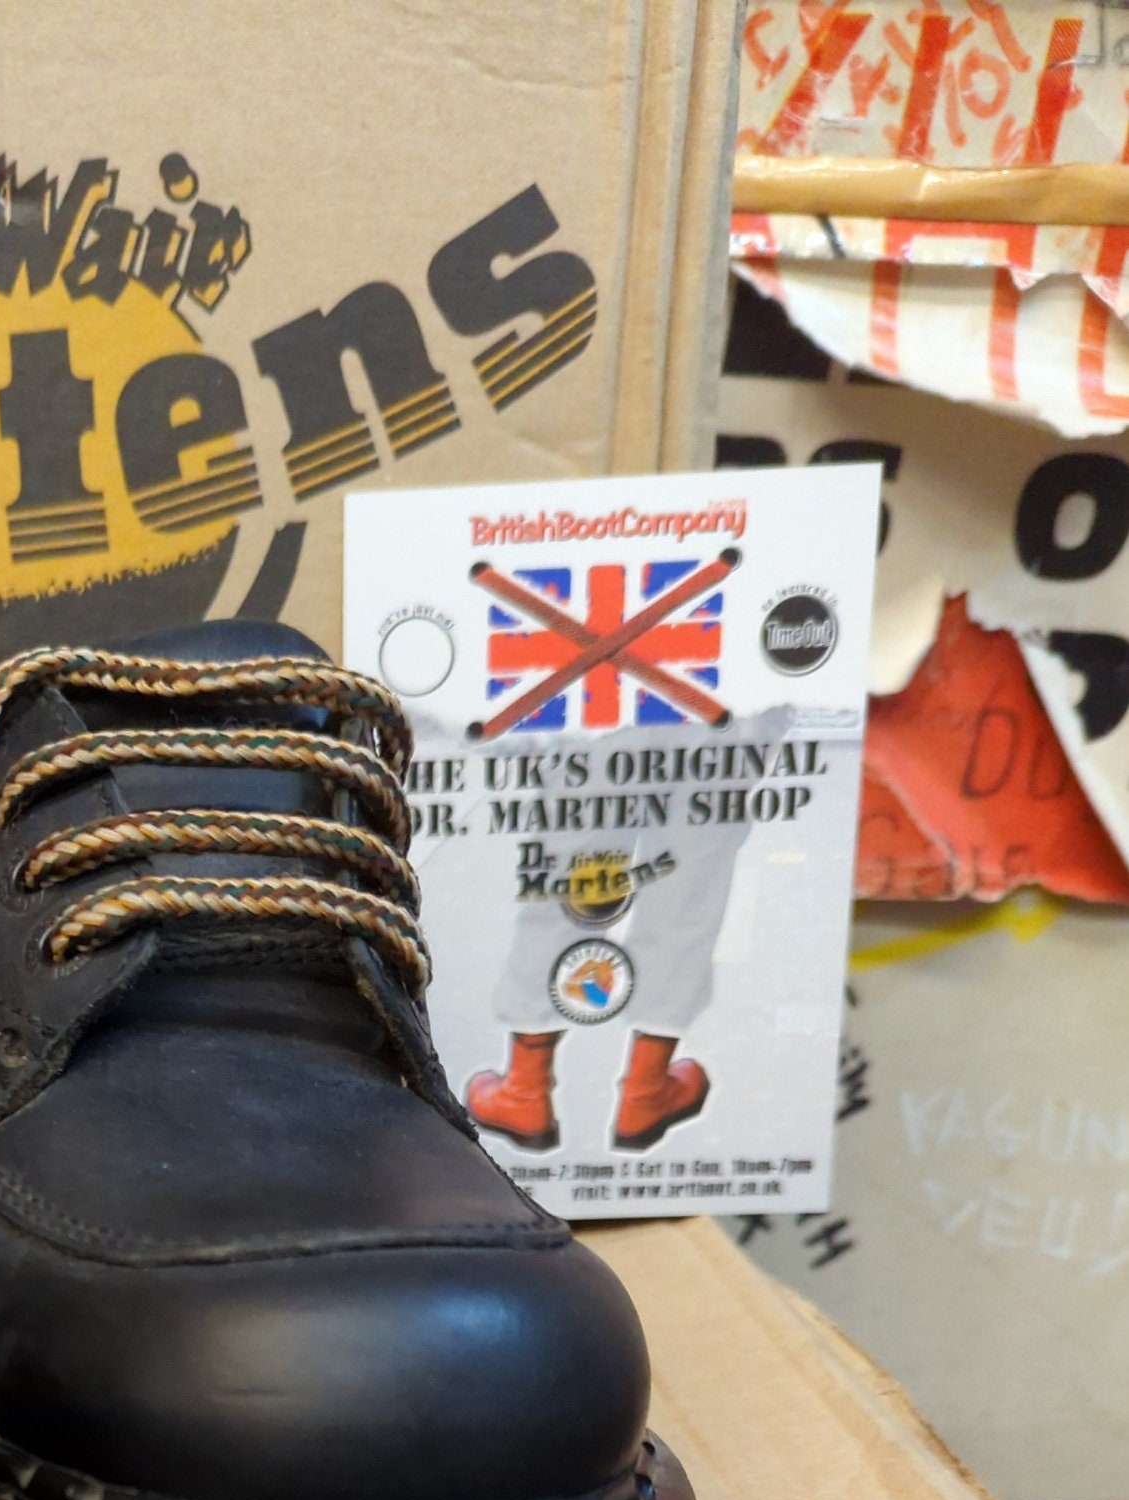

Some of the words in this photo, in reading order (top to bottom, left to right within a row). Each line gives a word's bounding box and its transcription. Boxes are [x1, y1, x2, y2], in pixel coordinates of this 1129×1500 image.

[406, 758, 465, 795] HE
[483, 751, 590, 791] UK'S
[605, 740, 828, 786] ORIGINAL
[487, 794, 672, 836] MARTEN
[686, 787, 813, 826] SHOP
[517, 850, 678, 903] Martens
